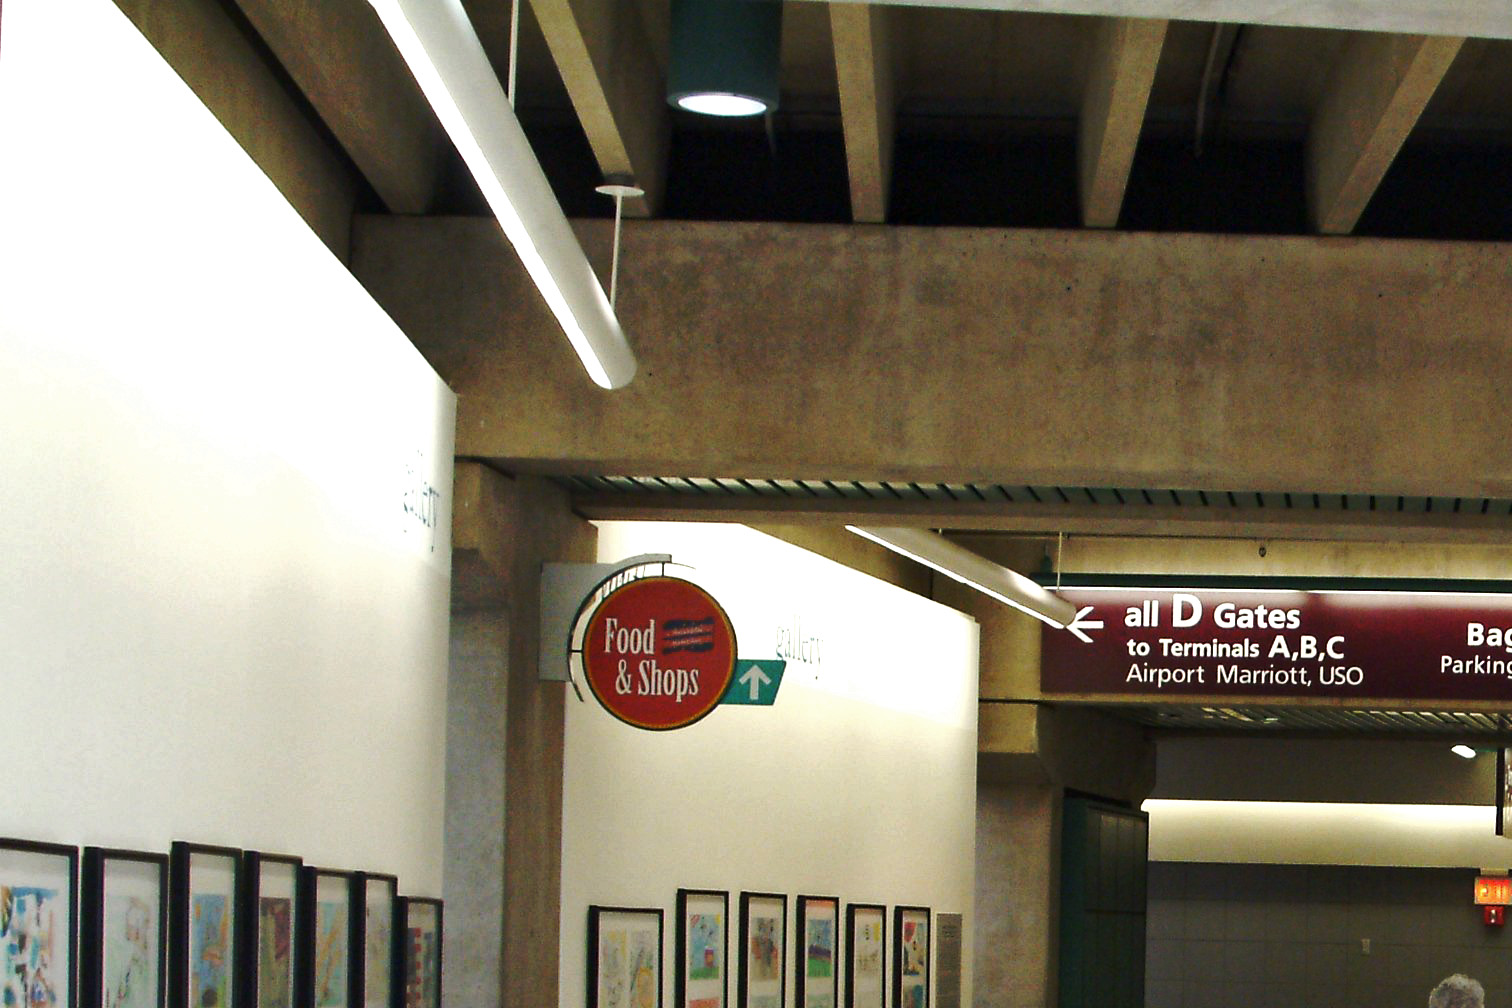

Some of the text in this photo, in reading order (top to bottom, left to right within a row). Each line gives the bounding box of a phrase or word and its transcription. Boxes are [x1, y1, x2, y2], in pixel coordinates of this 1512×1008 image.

[1124, 593, 1301, 629] all D Gates
[604, 617, 656, 654] Food
[1126, 635, 1345, 662] to Terminals A,B,C
[615, 659, 699, 702] & Shops
[1126, 663, 1364, 688] Airport Marriott, USO
